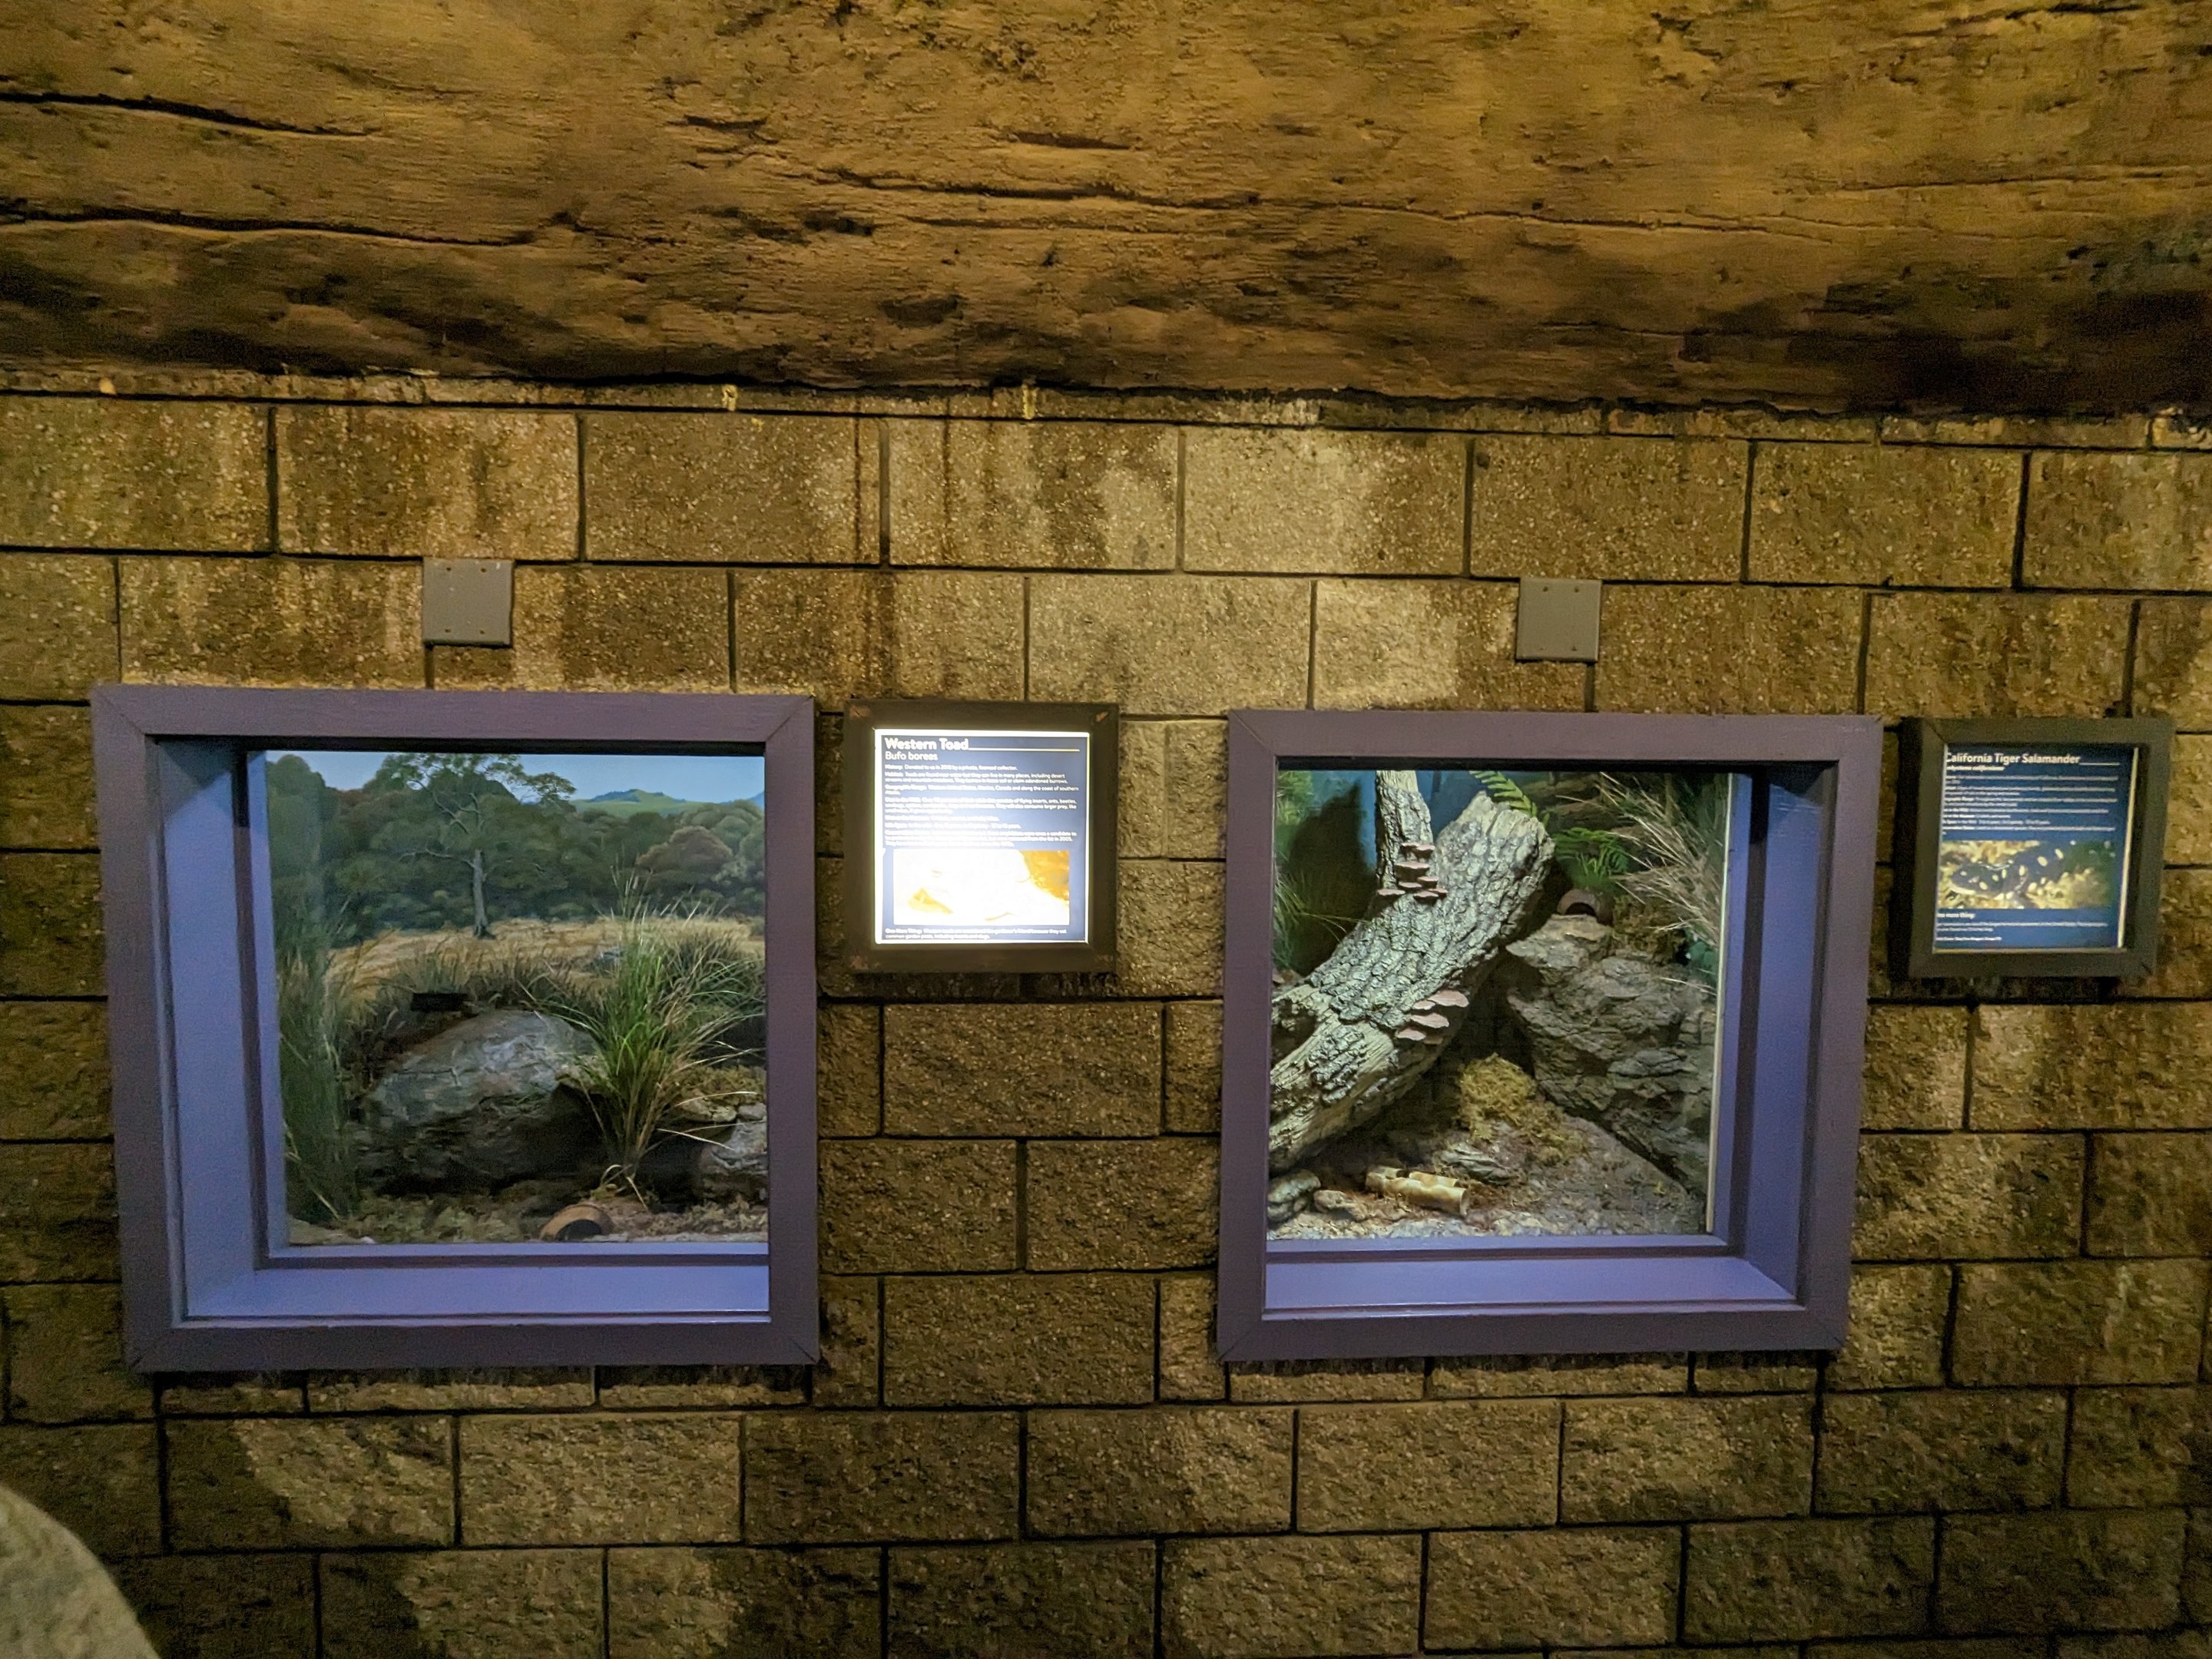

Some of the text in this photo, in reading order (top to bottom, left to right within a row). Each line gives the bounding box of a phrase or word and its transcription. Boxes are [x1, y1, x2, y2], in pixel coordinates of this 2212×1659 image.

[885, 737, 969, 750] Western Toad
[885, 751, 938, 760] Bufo boreas
[1945, 753, 2081, 766] California Tiger Salamander
